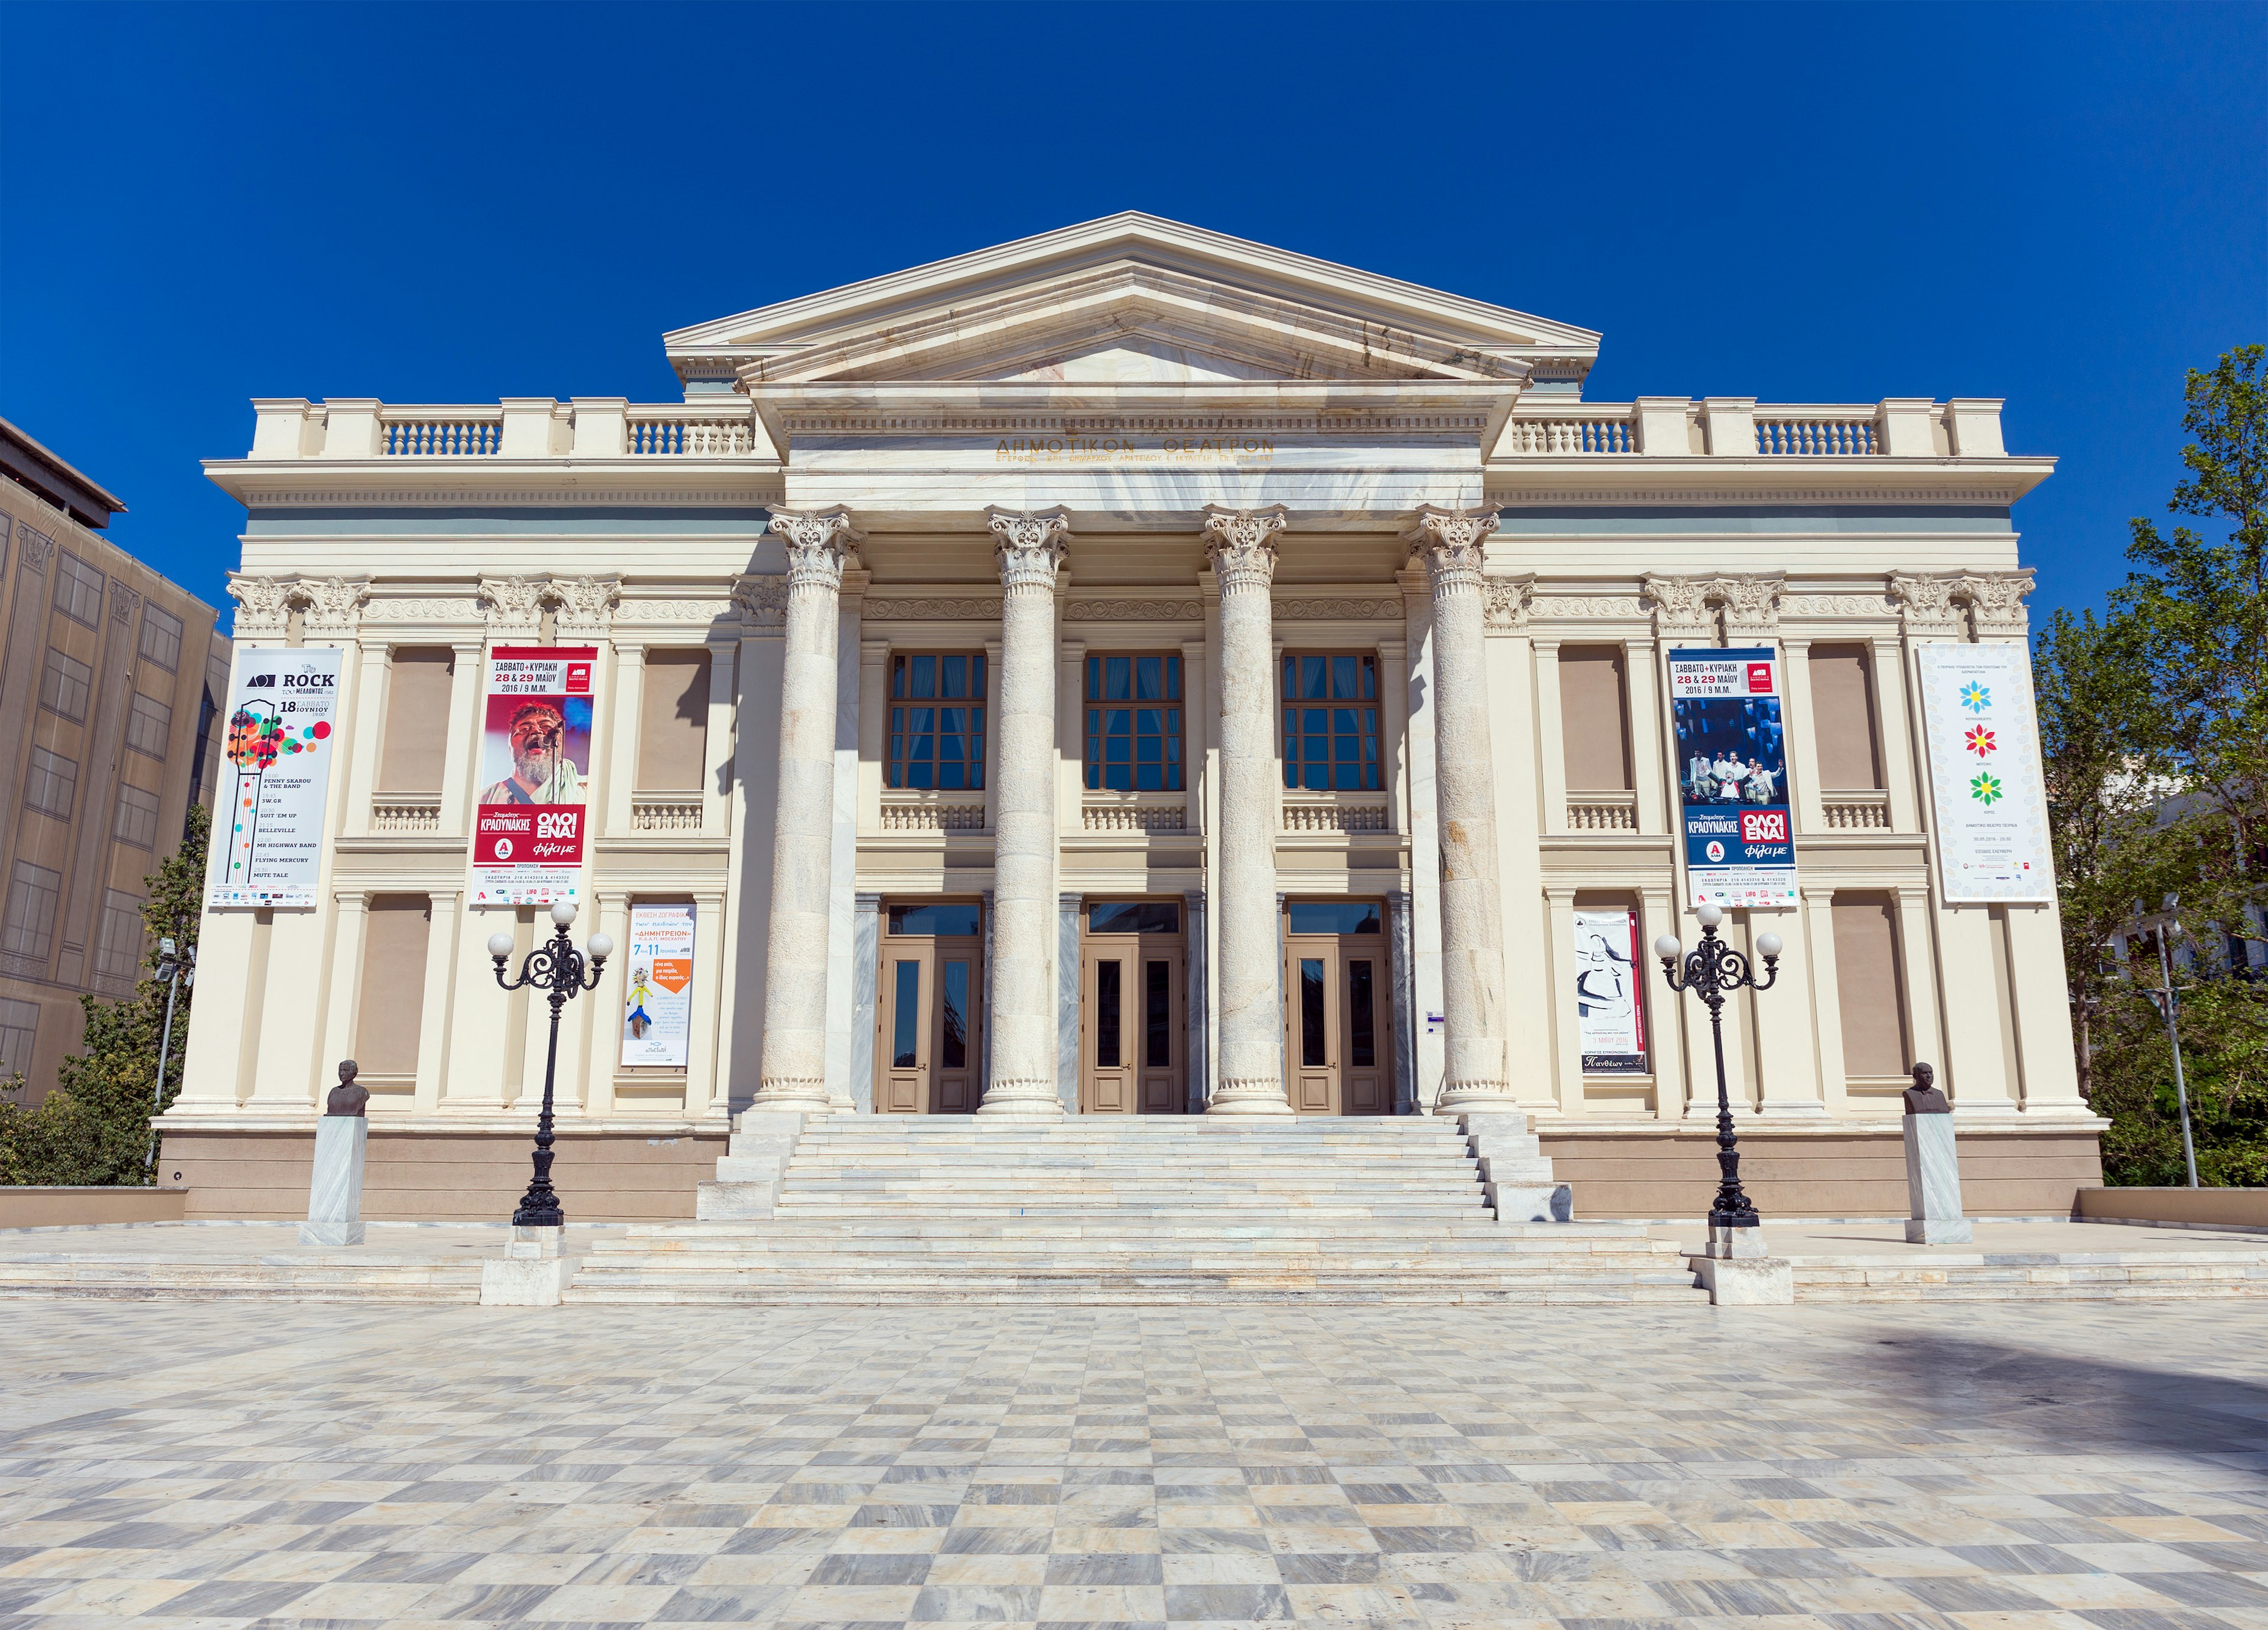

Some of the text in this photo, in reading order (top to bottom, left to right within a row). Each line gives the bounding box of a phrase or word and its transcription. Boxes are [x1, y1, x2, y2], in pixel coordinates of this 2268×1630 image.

[996, 438, 1273, 454] ΔΗΜΟΤΙΚΟΝ ΘΕΑΤΡΟΝ
[283, 674, 334, 687] ROCK
[495, 672, 556, 682] 28 & 29 ΜΑΪΟΥ
[1677, 676, 1692, 684] 28
[1717, 673, 1738, 683] ΜΑΪΟΥ
[531, 684, 548, 693] Μ.Μ.
[280, 701, 296, 712] 18
[480, 819, 531, 831] ΚΡΑΟΥΝΑΚΗΣ
[537, 813, 577, 826] ΟΛΟΙ
[1744, 814, 1784, 827] ΟΛΟΙ
[537, 825, 575, 838] ΕΝΑ!
[1688, 821, 1739, 833] ΚΡΑΟΥΝΑΚΗΣ
[1745, 827, 1785, 840] ΕΝΑ!
[533, 843, 576, 858] φίλα με
[1745, 845, 1787, 859] φίλα με
[634, 944, 641, 955] 7
[649, 944, 659, 956] 11
[1585, 1055, 1623, 1067] Πανθέων
